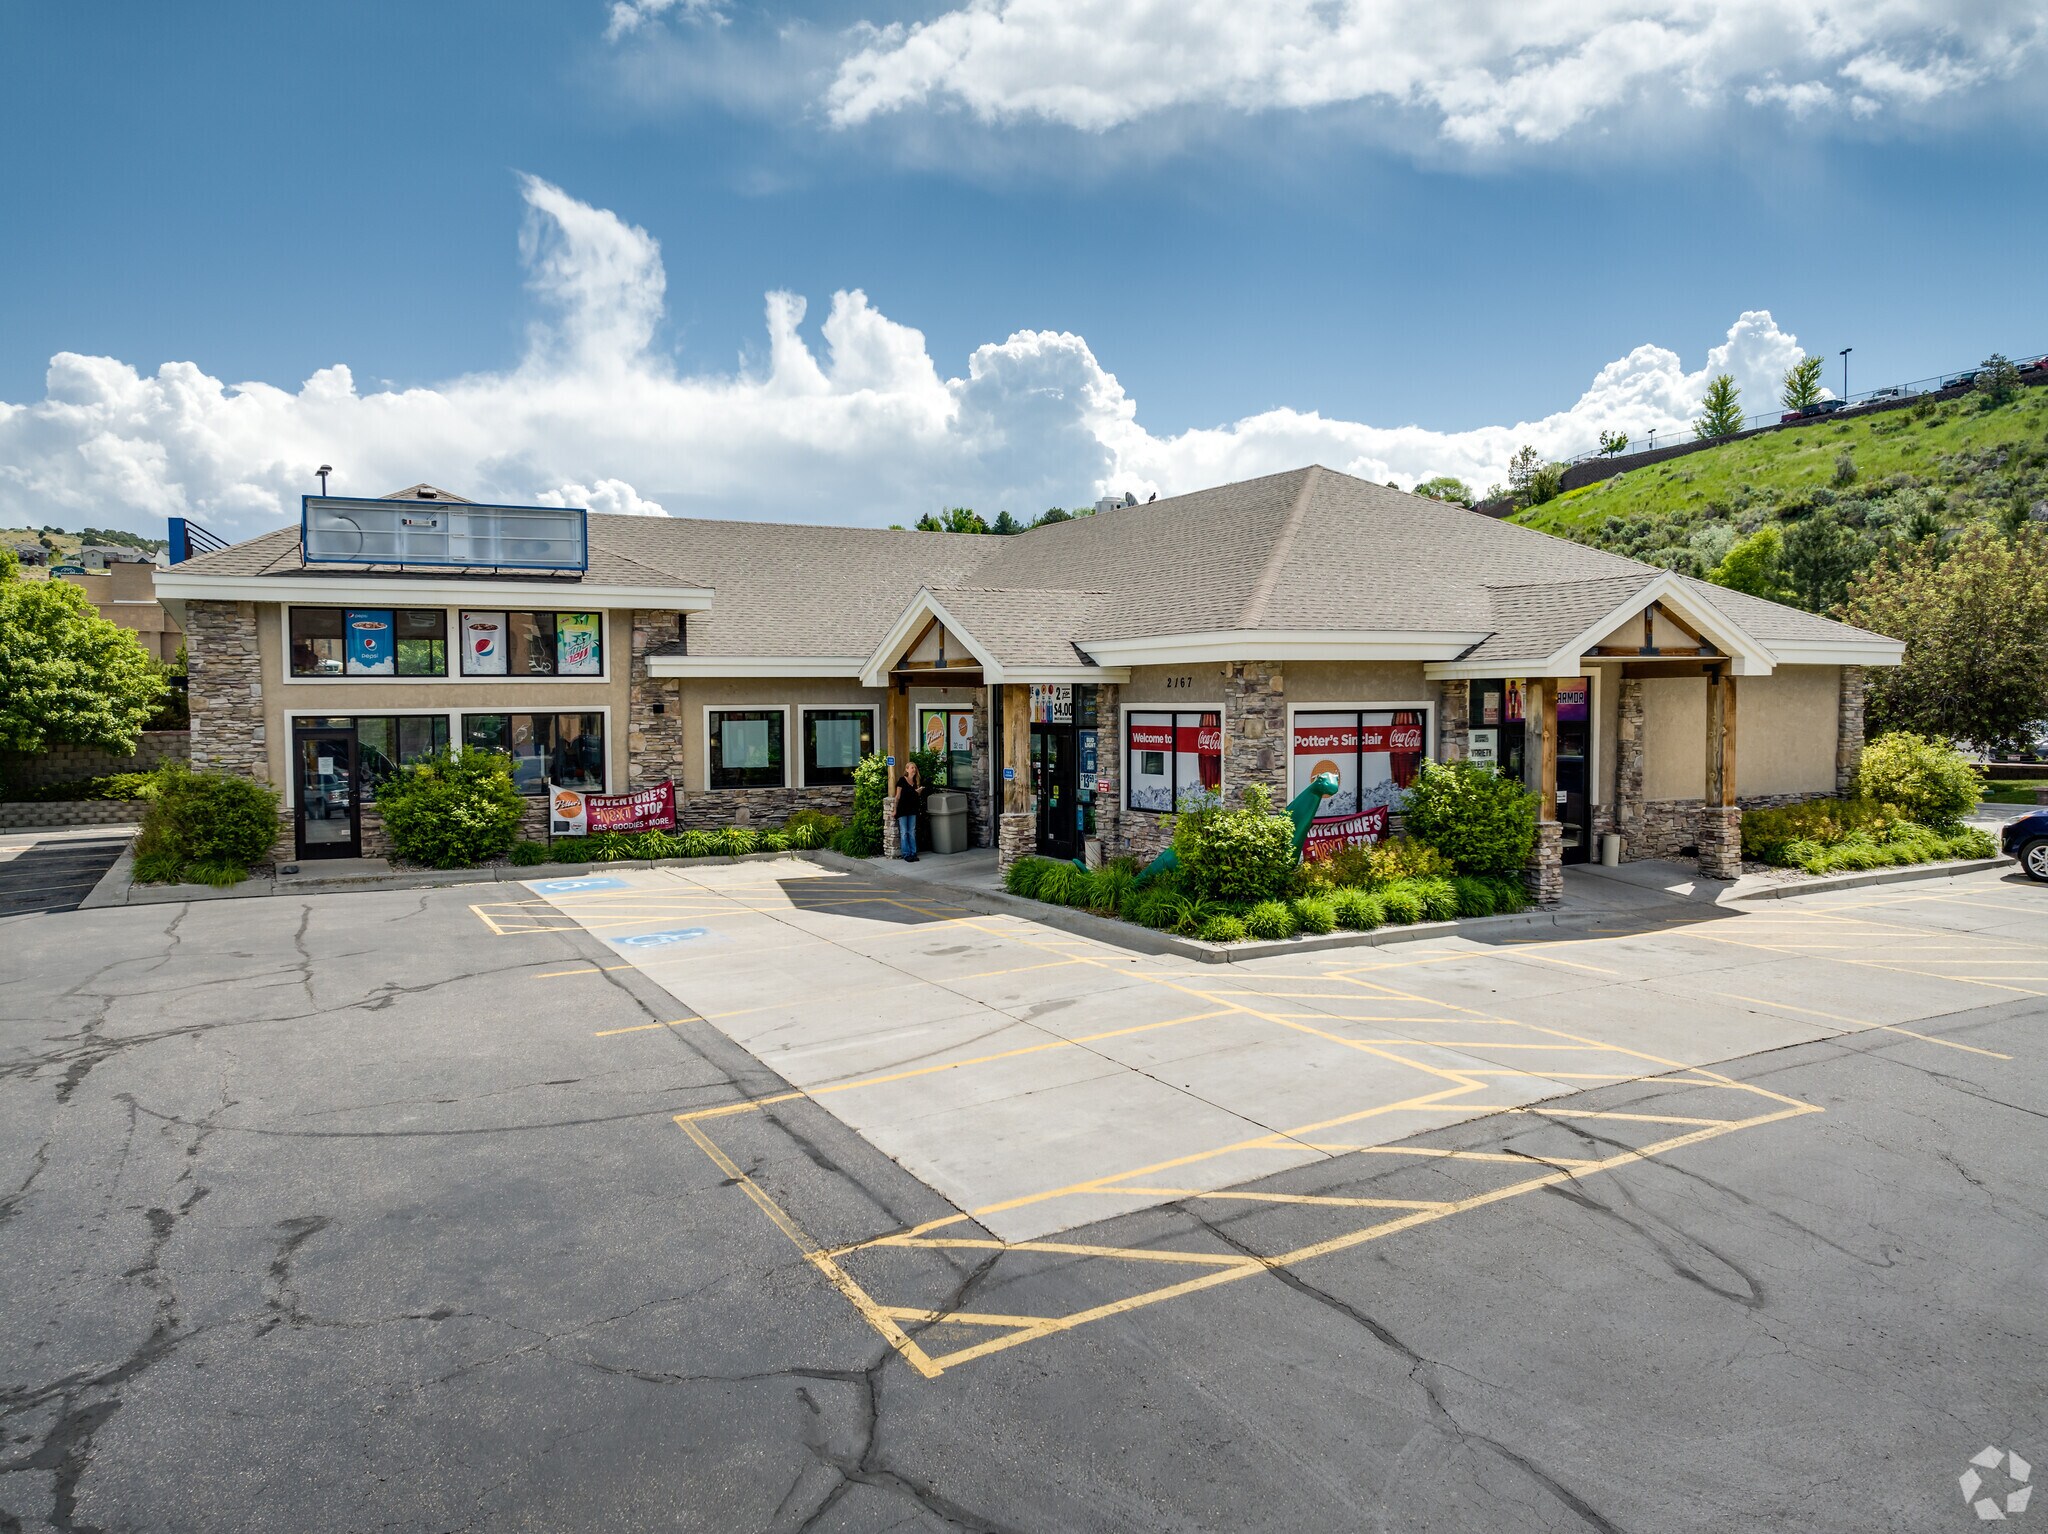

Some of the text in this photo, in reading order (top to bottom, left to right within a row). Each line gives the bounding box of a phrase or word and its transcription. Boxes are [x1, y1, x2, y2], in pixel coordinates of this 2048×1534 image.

[1167, 677, 1192, 688] 2167
[1056, 687, 1061, 700] 2
[1054, 703, 1072, 716] $4.00
[1132, 732, 1172, 744] Welcome to
[1294, 734, 1339, 747] Potter's
[589, 787, 667, 807] ADVENTURE'S
[635, 801, 663, 817] STOP
[592, 823, 607, 831] GAS
[612, 821, 644, 830] GOODIES
[649, 817, 669, 826] MORE
